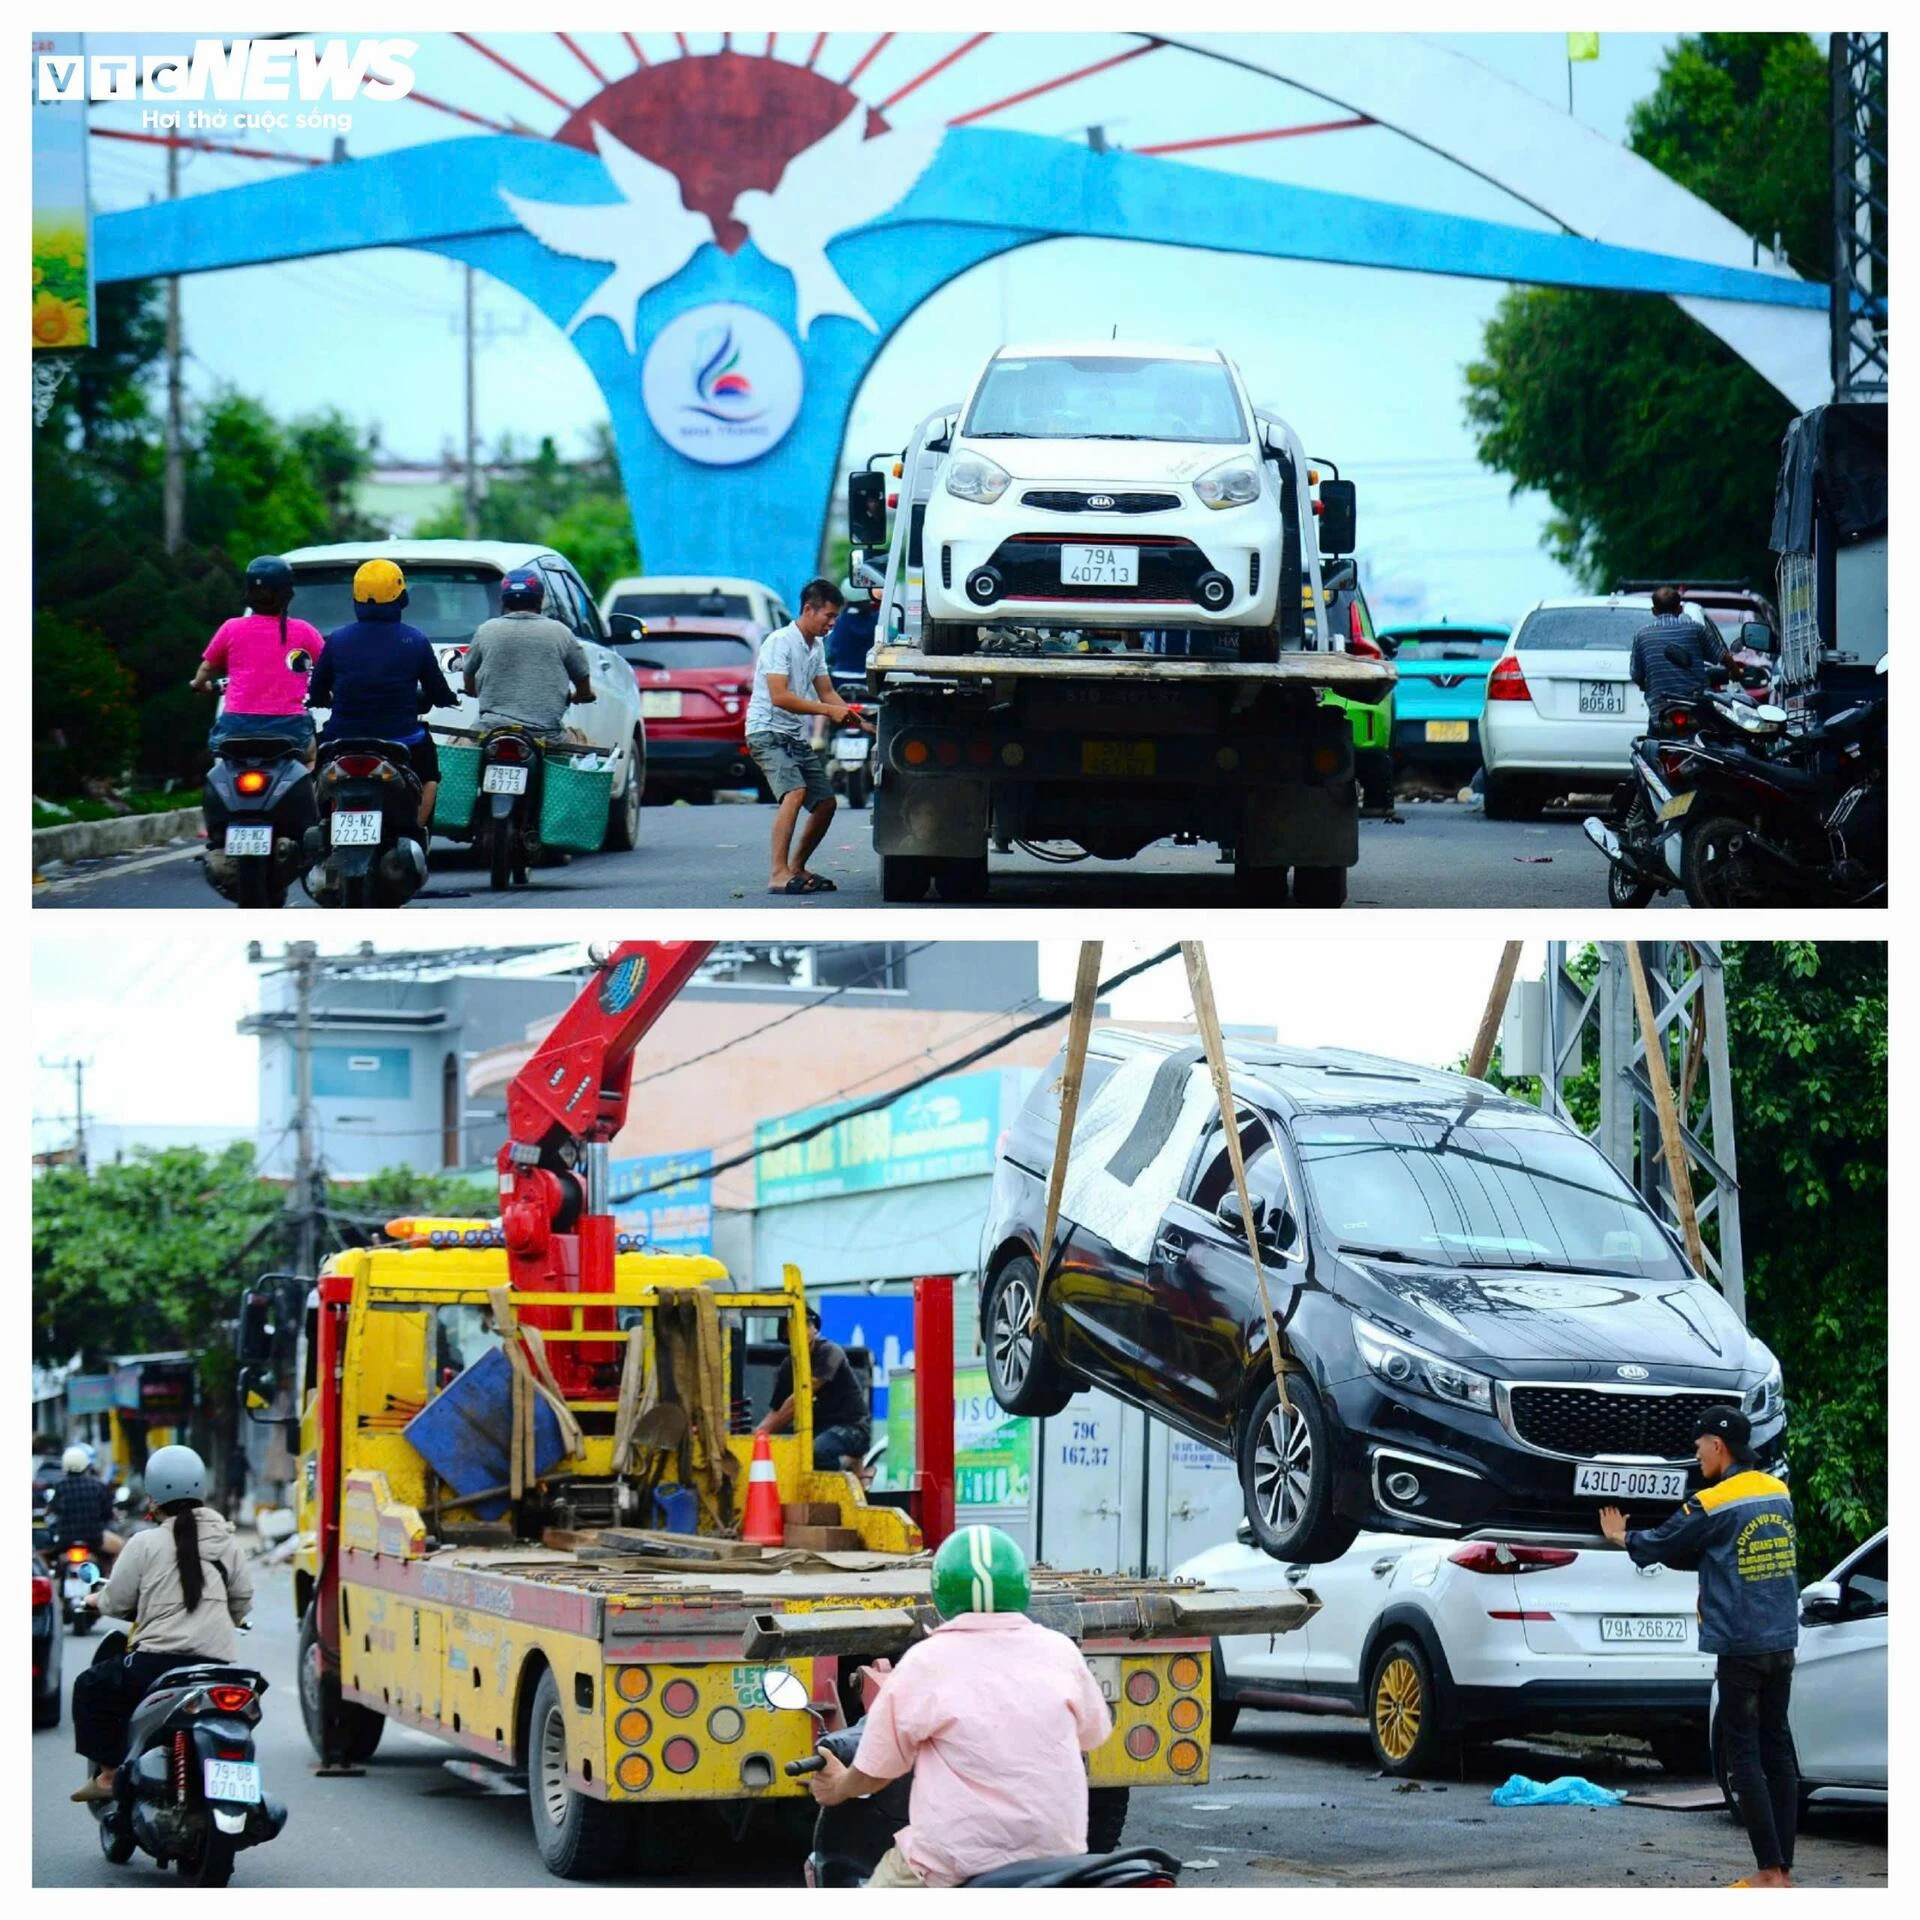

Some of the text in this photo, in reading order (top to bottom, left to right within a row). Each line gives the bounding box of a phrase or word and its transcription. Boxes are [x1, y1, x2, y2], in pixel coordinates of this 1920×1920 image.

[1084, 549, 1116, 565] 79A
[1070, 566, 1129, 583] 407.13
[1591, 682, 1614, 697] 29A
[334, 828, 377, 843] 222.54
[1072, 1421, 1100, 1440] 79C
[1580, 1469, 1682, 1496] 43LD-003.32
